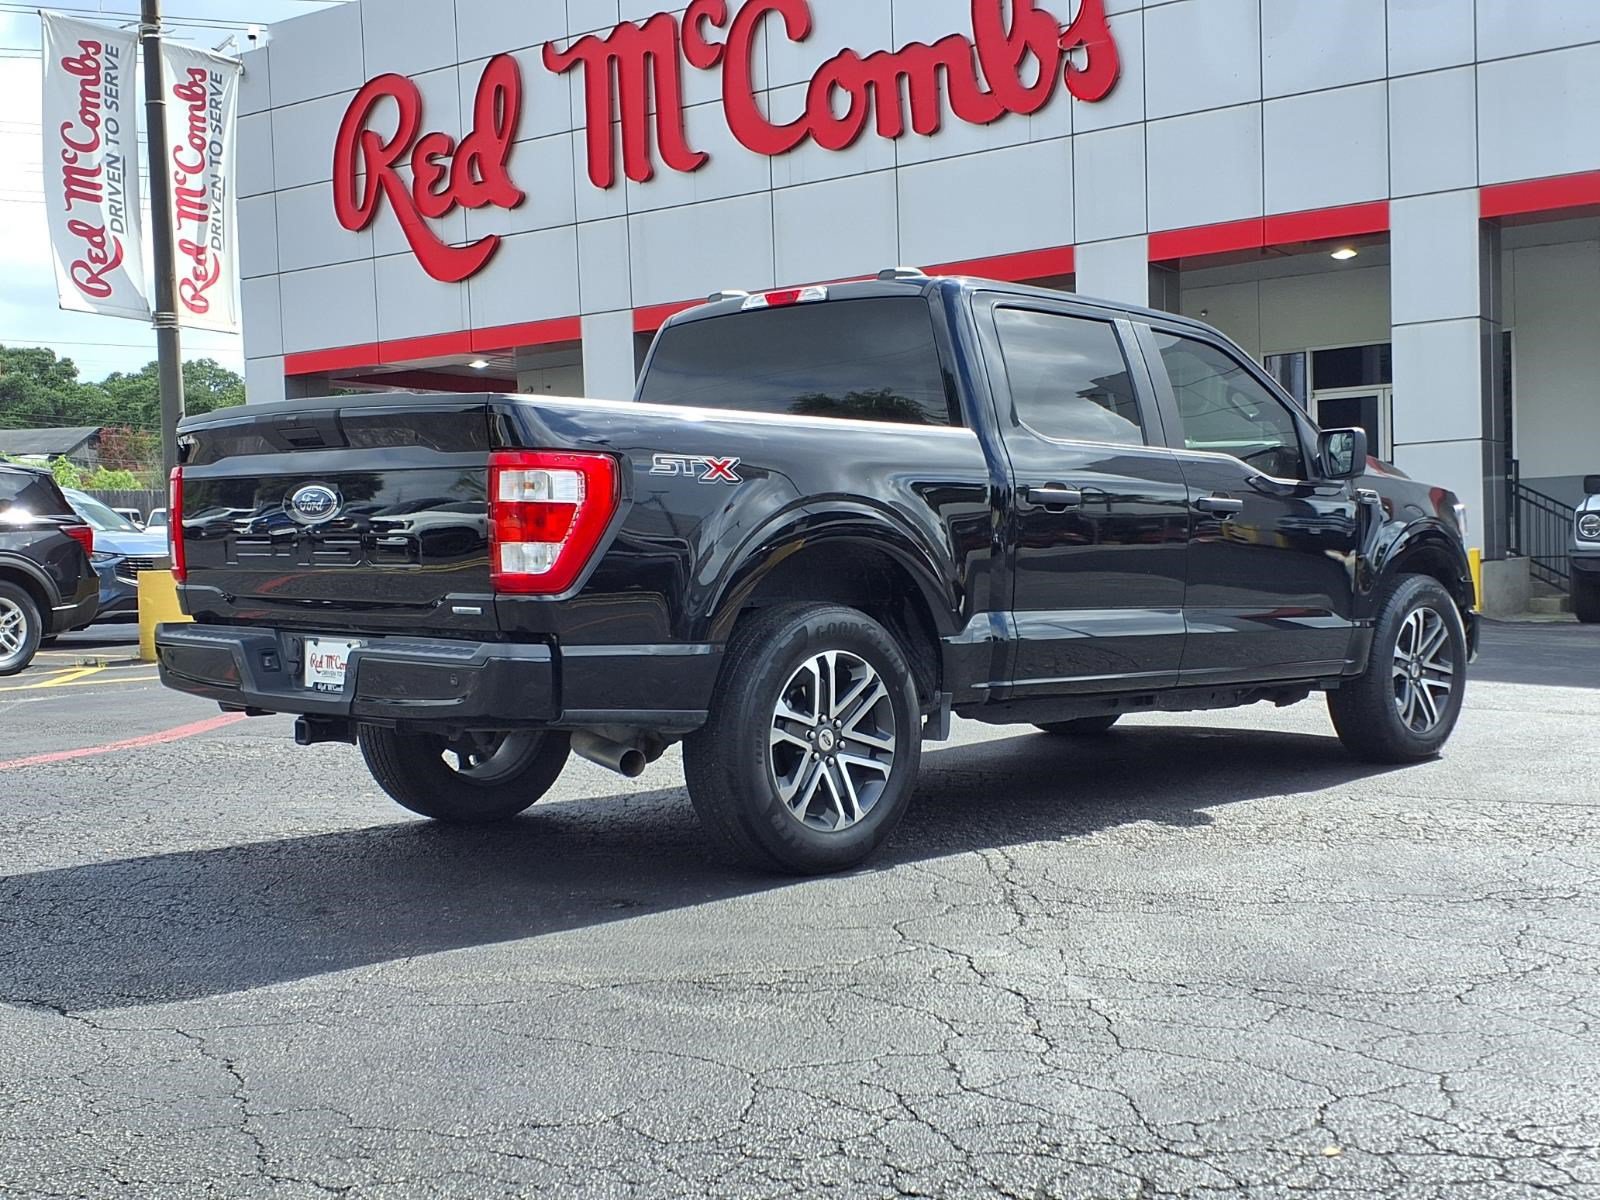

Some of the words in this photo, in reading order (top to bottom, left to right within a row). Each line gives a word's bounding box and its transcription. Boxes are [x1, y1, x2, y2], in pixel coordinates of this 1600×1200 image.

[104, 43, 120, 112] SERVE
[209, 71, 223, 135] SERVE
[59, 39, 104, 212] McCombs
[104, 117, 120, 147] TO
[172, 67, 209, 230] McCombs
[209, 140, 223, 167] TO
[333, 54, 526, 283] Red
[542, 0, 1120, 190] McCombs
[105, 153, 125, 234] DRIVEN
[210, 173, 223, 251] DRIVEN
[68, 219, 124, 298] Red
[178, 239, 220, 314] Red
[300, 492, 325, 511] Ford
[649, 453, 743, 485] STX
[310, 652, 323, 674] Red
